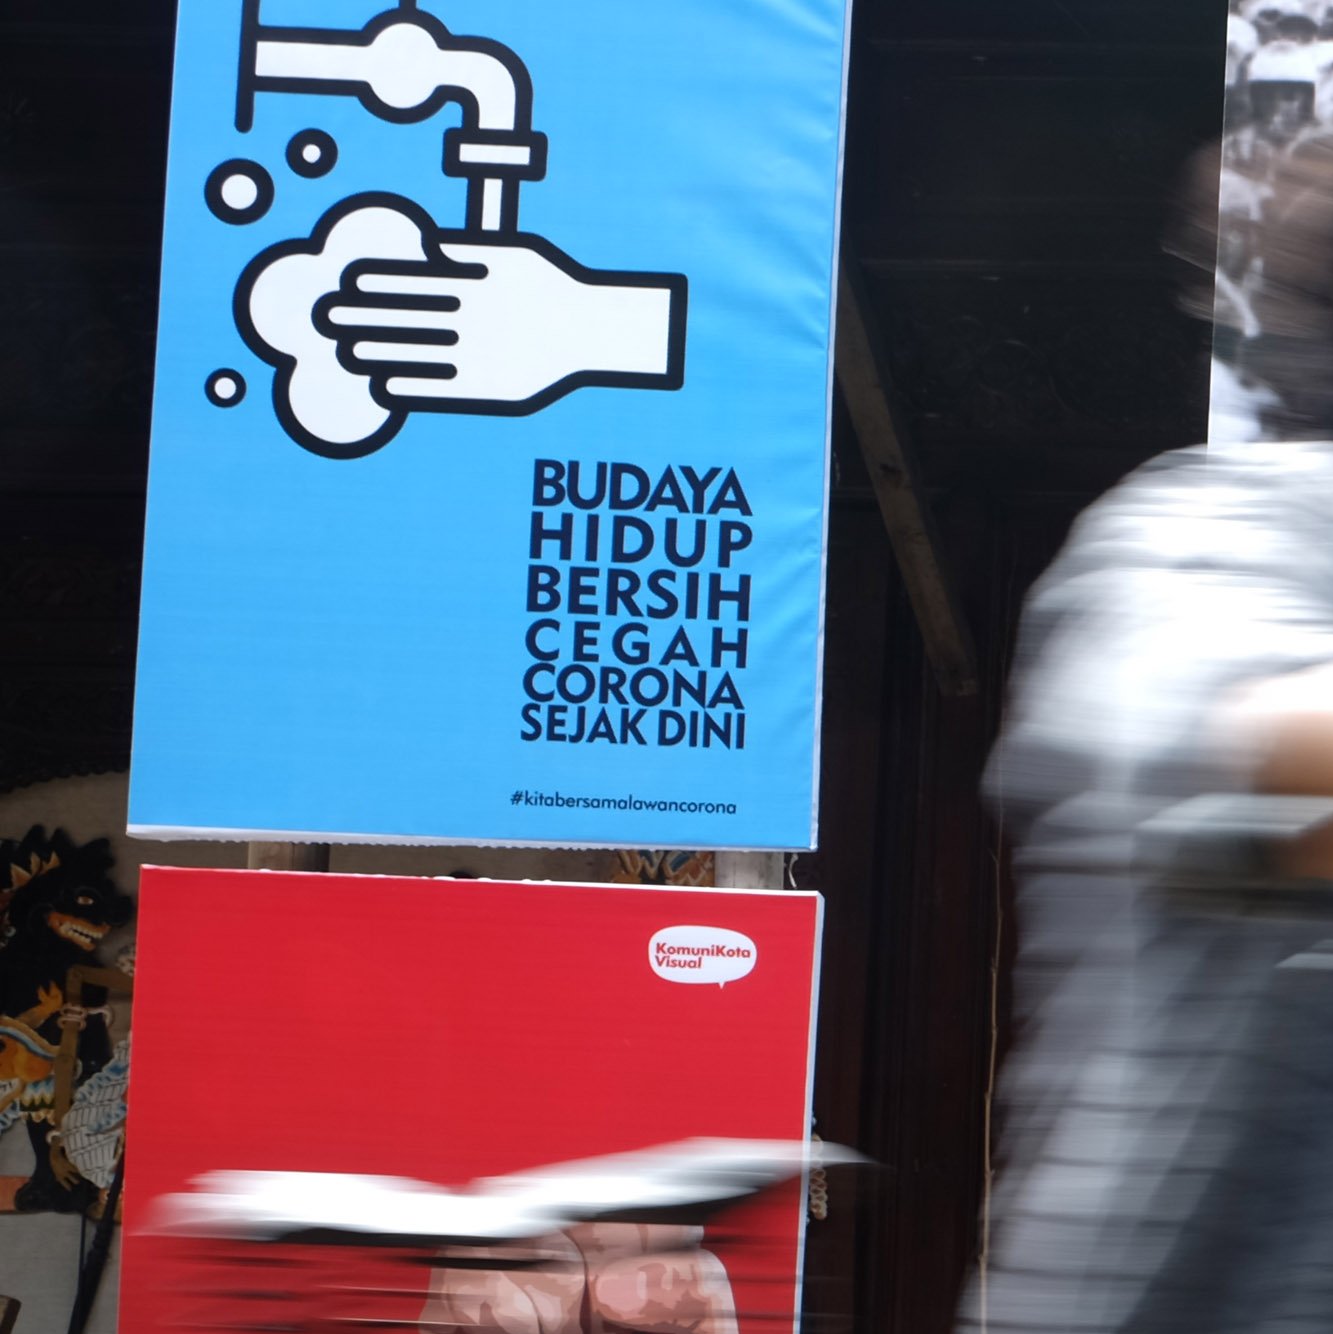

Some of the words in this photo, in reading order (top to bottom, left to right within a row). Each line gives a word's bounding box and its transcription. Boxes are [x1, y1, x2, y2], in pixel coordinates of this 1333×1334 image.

[532, 458, 753, 517] BUDAYA
[529, 512, 754, 568] HIDUP
[526, 565, 752, 621] BERSIH
[525, 618, 749, 669] CEGAH
[522, 662, 744, 710] CORONA
[520, 702, 648, 747] SEJAK
[656, 707, 745, 750] DINI
[510, 790, 737, 814] #kitabersamalawancorona
[655, 956, 702, 969] Visual
[656, 942, 751, 958] KomuniKota
